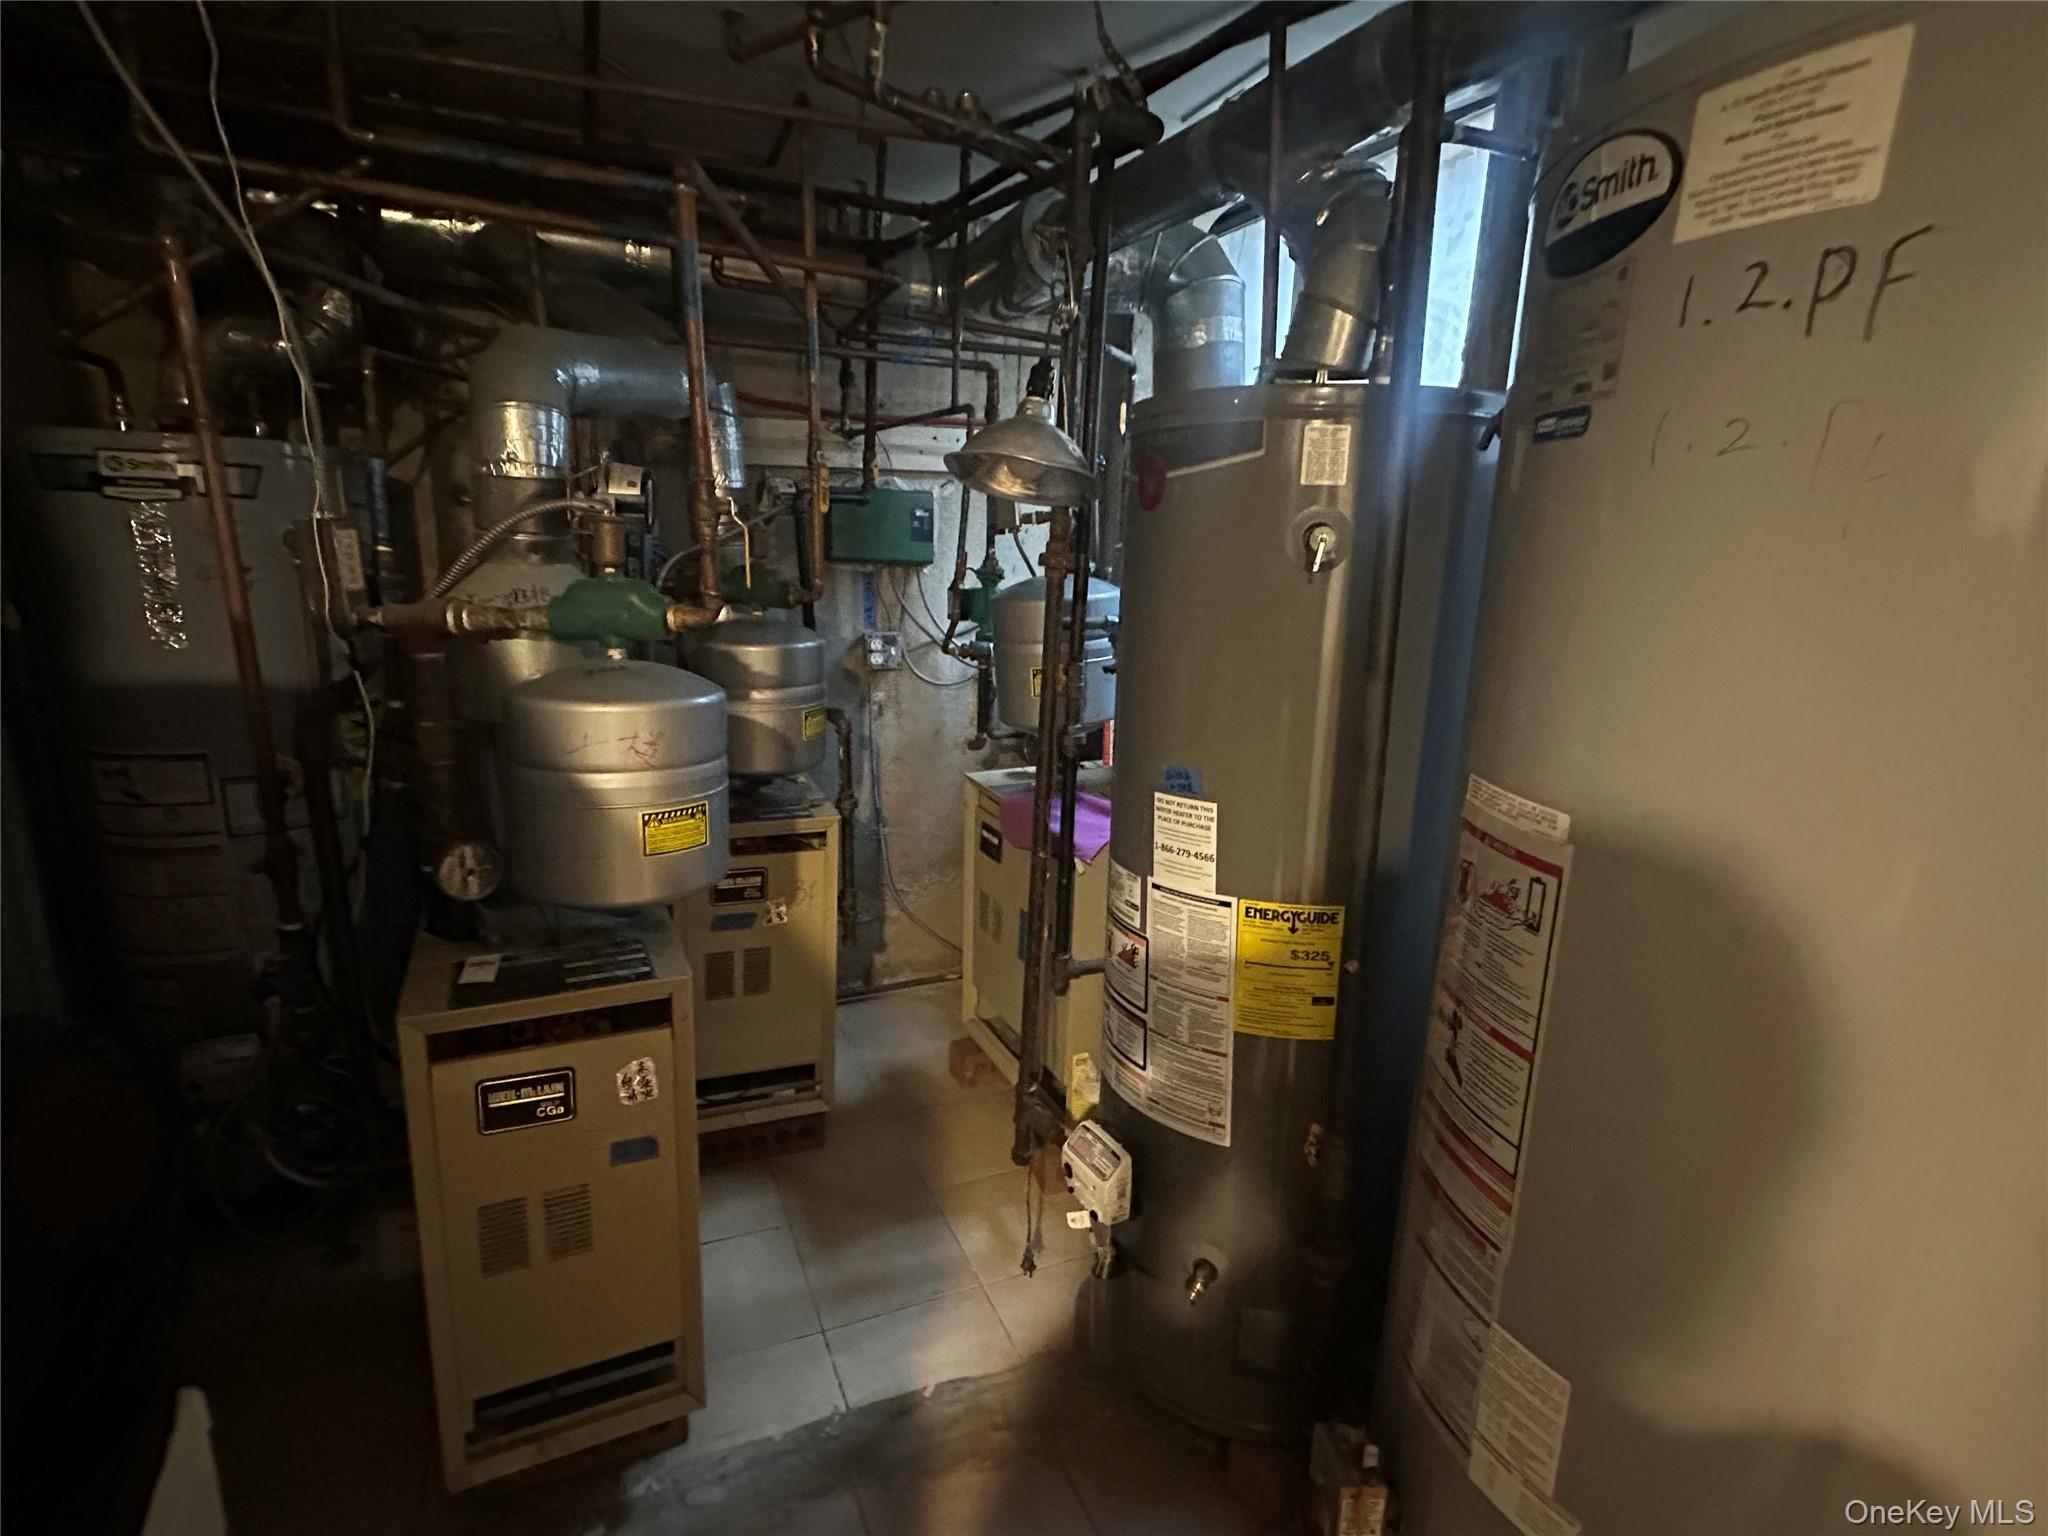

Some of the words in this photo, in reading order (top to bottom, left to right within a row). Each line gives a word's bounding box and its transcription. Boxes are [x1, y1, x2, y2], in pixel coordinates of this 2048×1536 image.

[1176, 802, 1199, 811] RETURN
[1200, 805, 1214, 814] THIS
[1158, 815, 1172, 823] PLACE
[1181, 820, 1212, 831] PURCHASE
[1173, 810, 1193, 818] HEATER
[1194, 813, 1202, 821] TO
[1203, 815, 1215, 823] THE
[1154, 841, 1215, 863] 1-866-279-4566
[1290, 949, 1331, 962] $325
